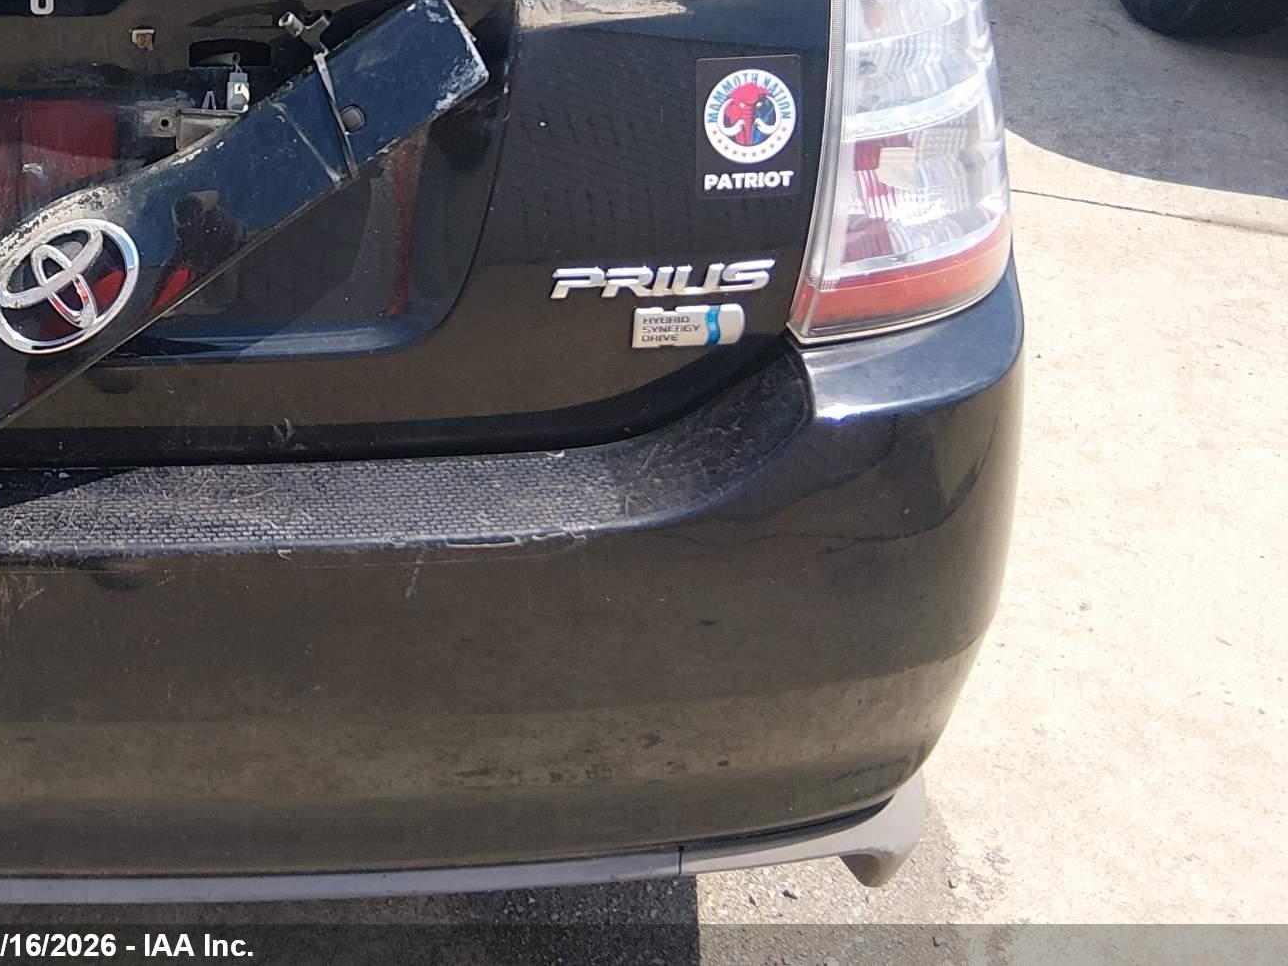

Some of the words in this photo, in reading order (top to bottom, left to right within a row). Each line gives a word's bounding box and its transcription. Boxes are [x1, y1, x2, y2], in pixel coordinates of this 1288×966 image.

[707, 72, 759, 124] MAMMOTH
[762, 76, 792, 120] NATION
[703, 170, 794, 191] PATRIOT
[550, 258, 776, 299] PRIUS
[642, 315, 690, 325] HYBRID
[642, 324, 701, 333] SYNERGY
[641, 333, 680, 342] DRIVE
